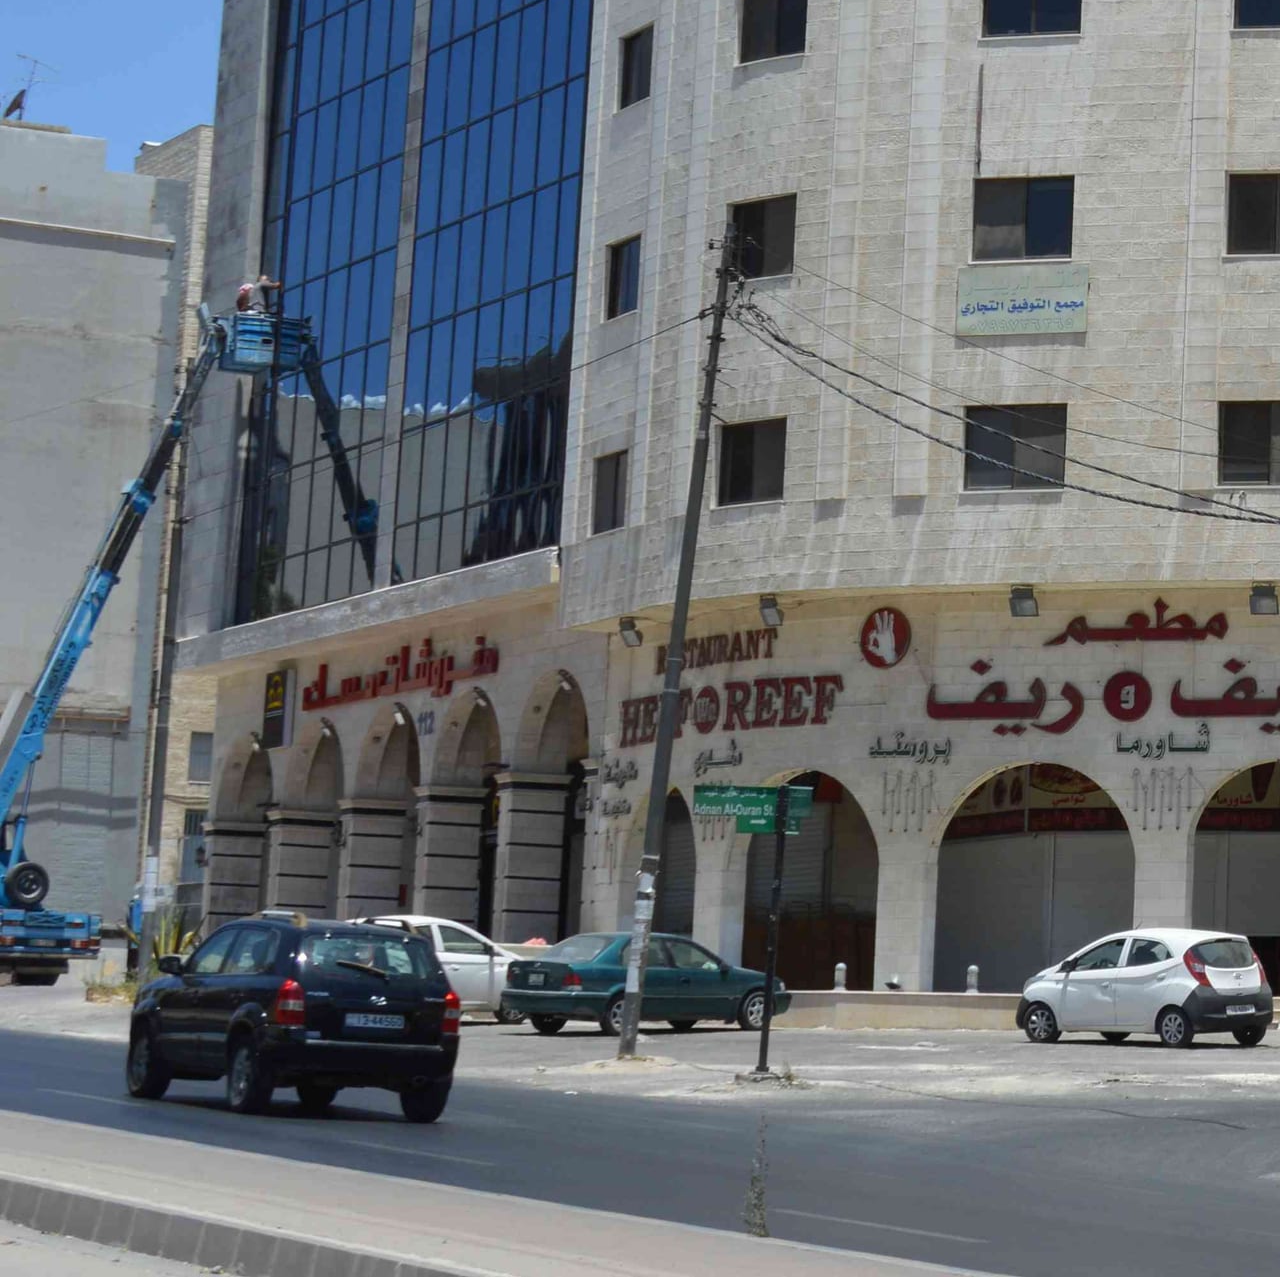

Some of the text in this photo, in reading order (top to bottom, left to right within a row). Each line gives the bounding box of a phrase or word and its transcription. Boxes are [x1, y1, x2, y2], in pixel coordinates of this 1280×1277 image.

[960, 297, 1085, 317] مجمع التوفيق التجاري
[1043, 596, 1229, 646] مطعم
[722, 674, 845, 732] REEF
[926, 658, 1086, 736] ريف
[693, 803, 722, 815] Adnan
[763, 804, 775, 816] St.
